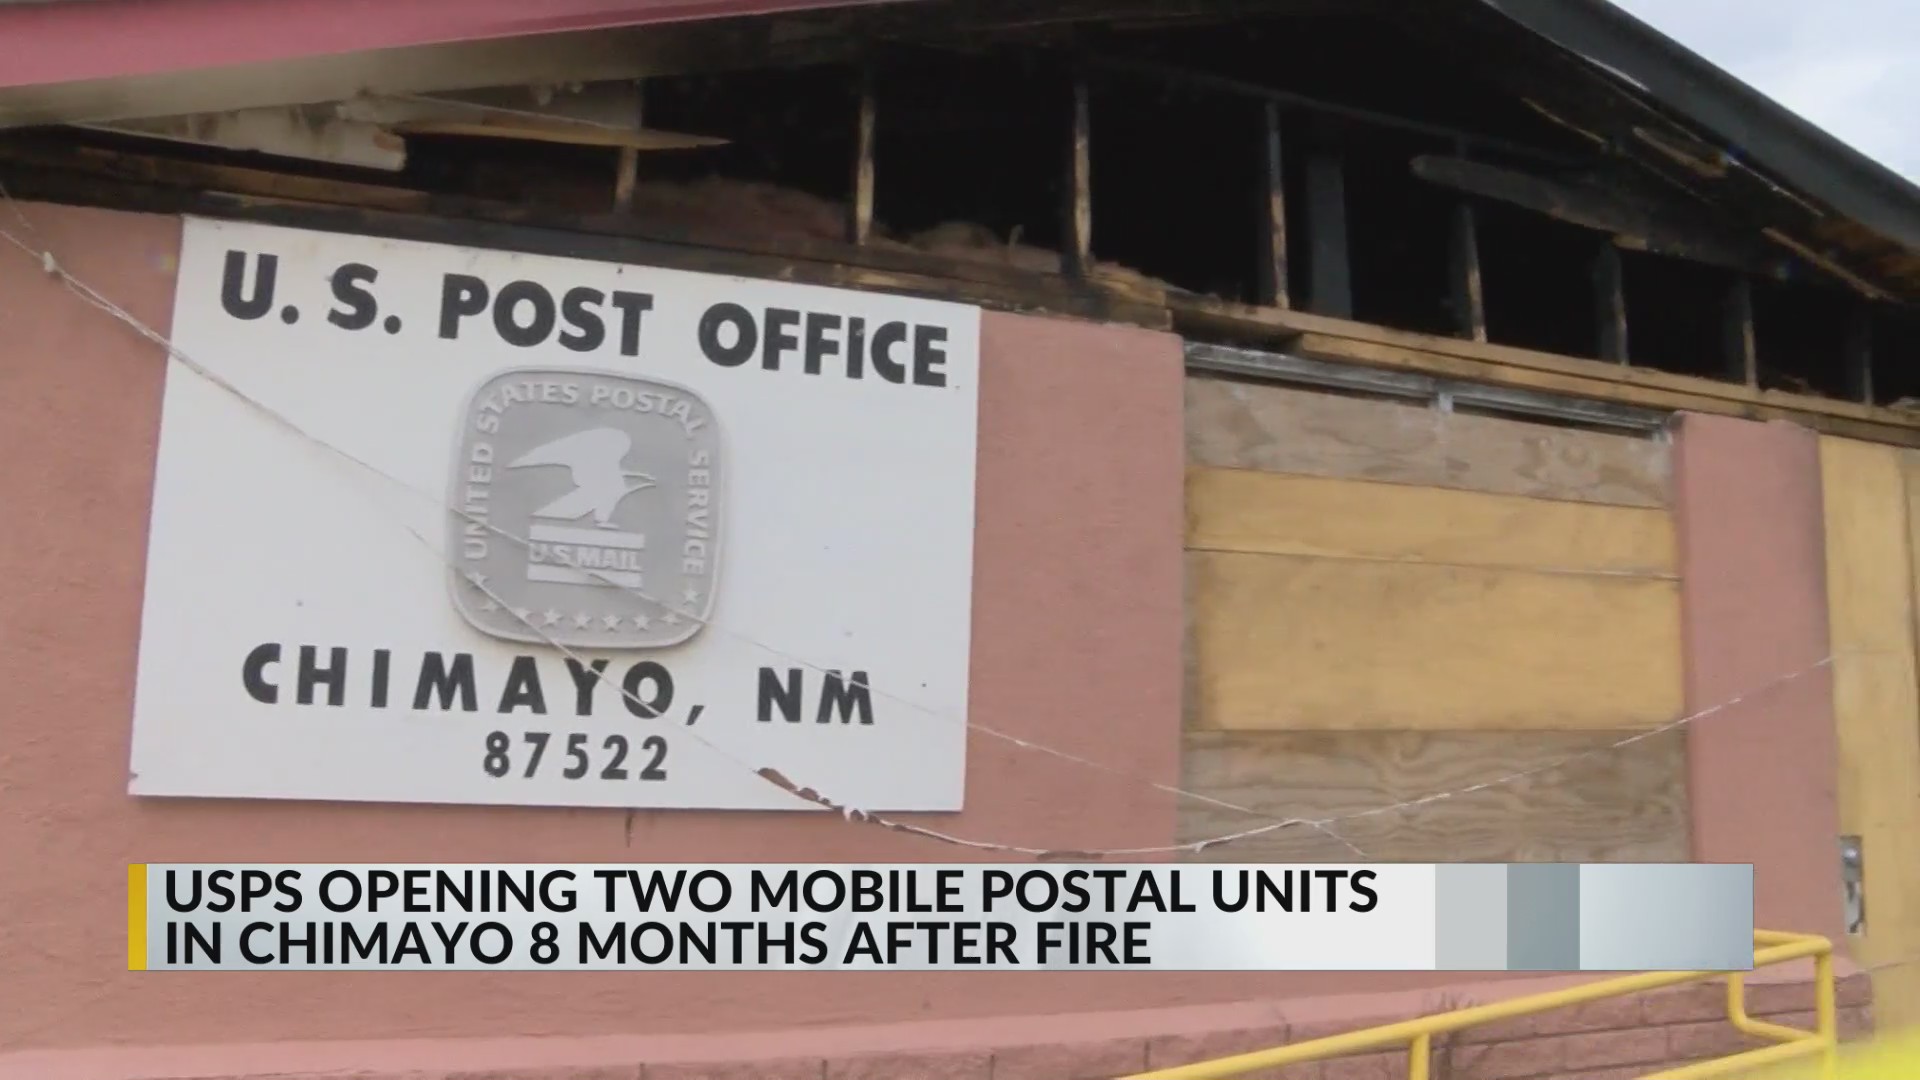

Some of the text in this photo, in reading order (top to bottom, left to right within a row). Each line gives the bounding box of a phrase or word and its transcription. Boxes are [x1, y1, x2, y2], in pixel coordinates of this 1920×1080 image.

[438, 273, 654, 356] POST
[697, 302, 948, 388] OFFICE
[464, 382, 710, 576] UNITED STATES POSTAL SERVICE
[241, 643, 875, 727] CHIMAYO, NM
[483, 731, 668, 782] 87522
